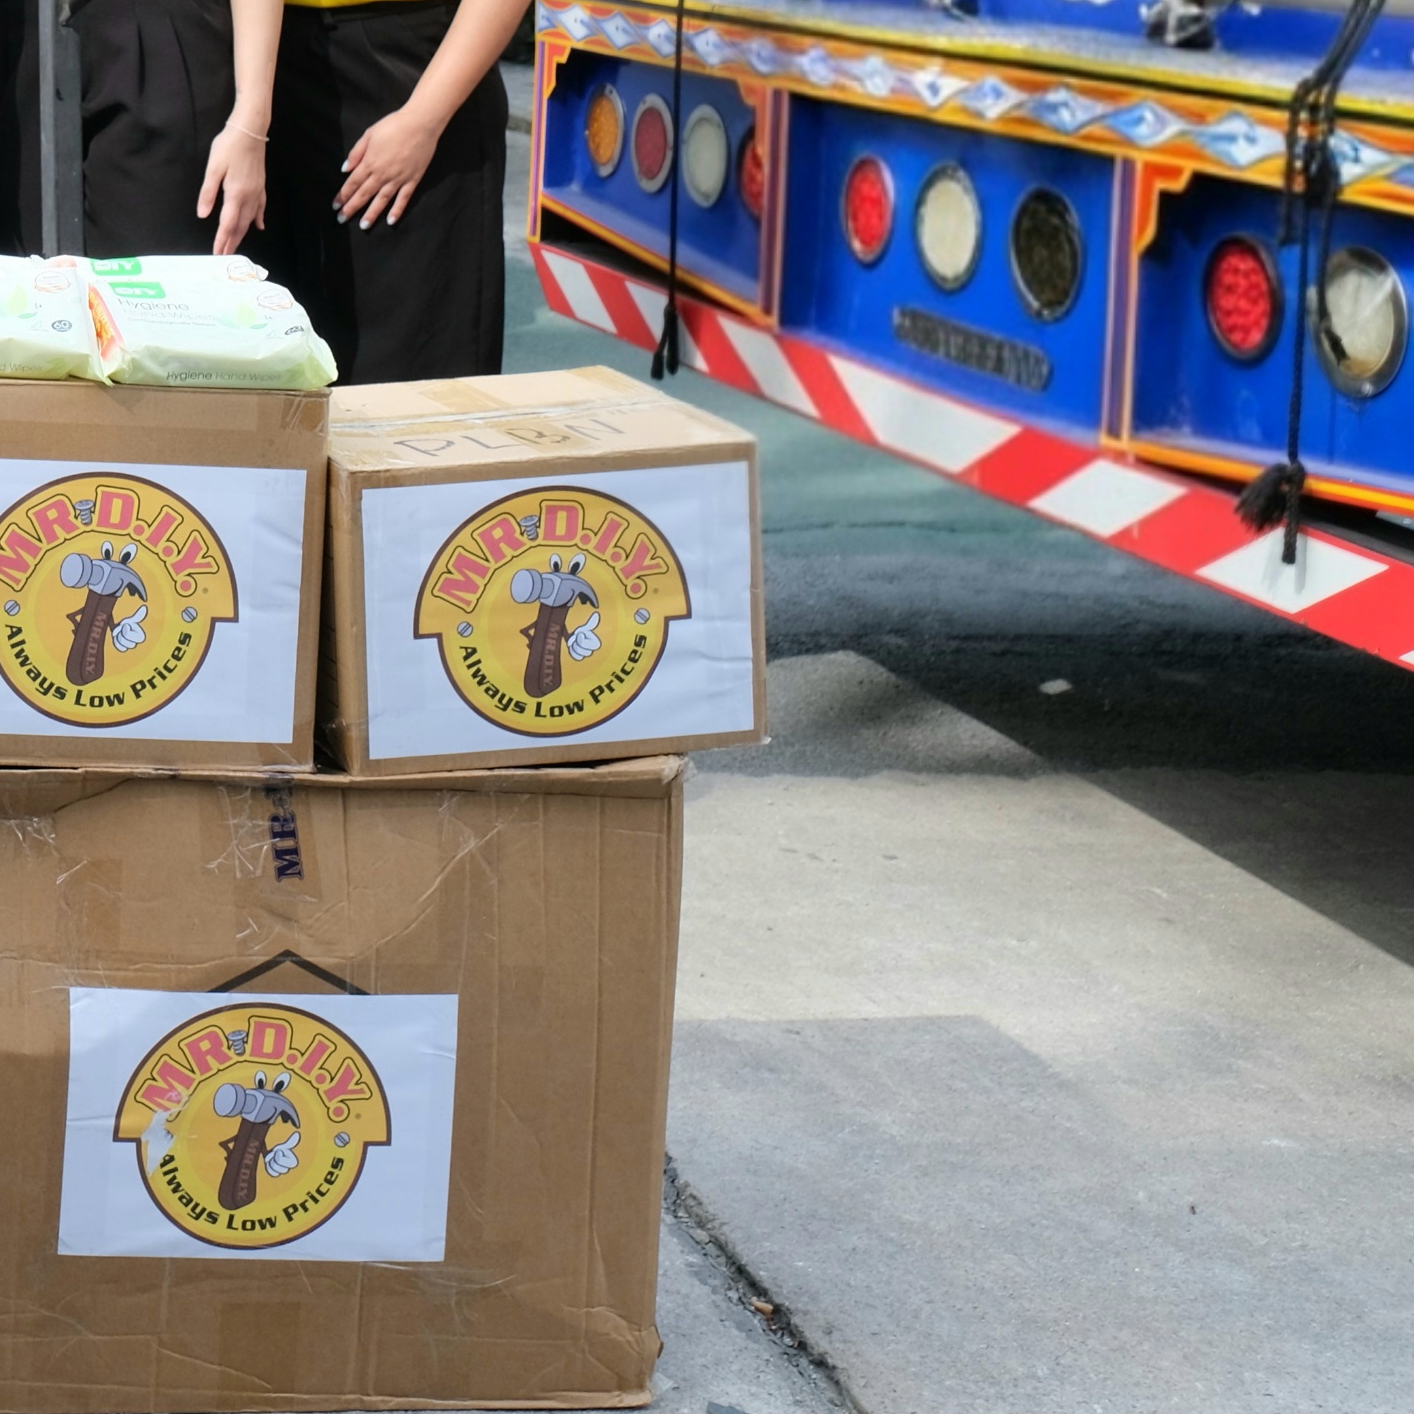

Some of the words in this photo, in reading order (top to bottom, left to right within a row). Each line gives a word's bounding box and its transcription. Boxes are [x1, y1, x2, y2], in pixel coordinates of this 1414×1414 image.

[118, 297, 189, 311] Hygiene
[166, 370, 213, 382] Hygiene
[215, 371, 246, 381] Hand
[249, 371, 283, 383] Wipes
[4, 622, 68, 701] Always
[73, 688, 125, 708] Low
[129, 631, 193, 700] Prices
[458, 644, 528, 716] Always
[534, 697, 585, 719] Low
[588, 632, 648, 708] Prices
[158, 1152, 219, 1226] Always
[226, 1212, 279, 1233] Low
[281, 1155, 346, 1224] Prices
